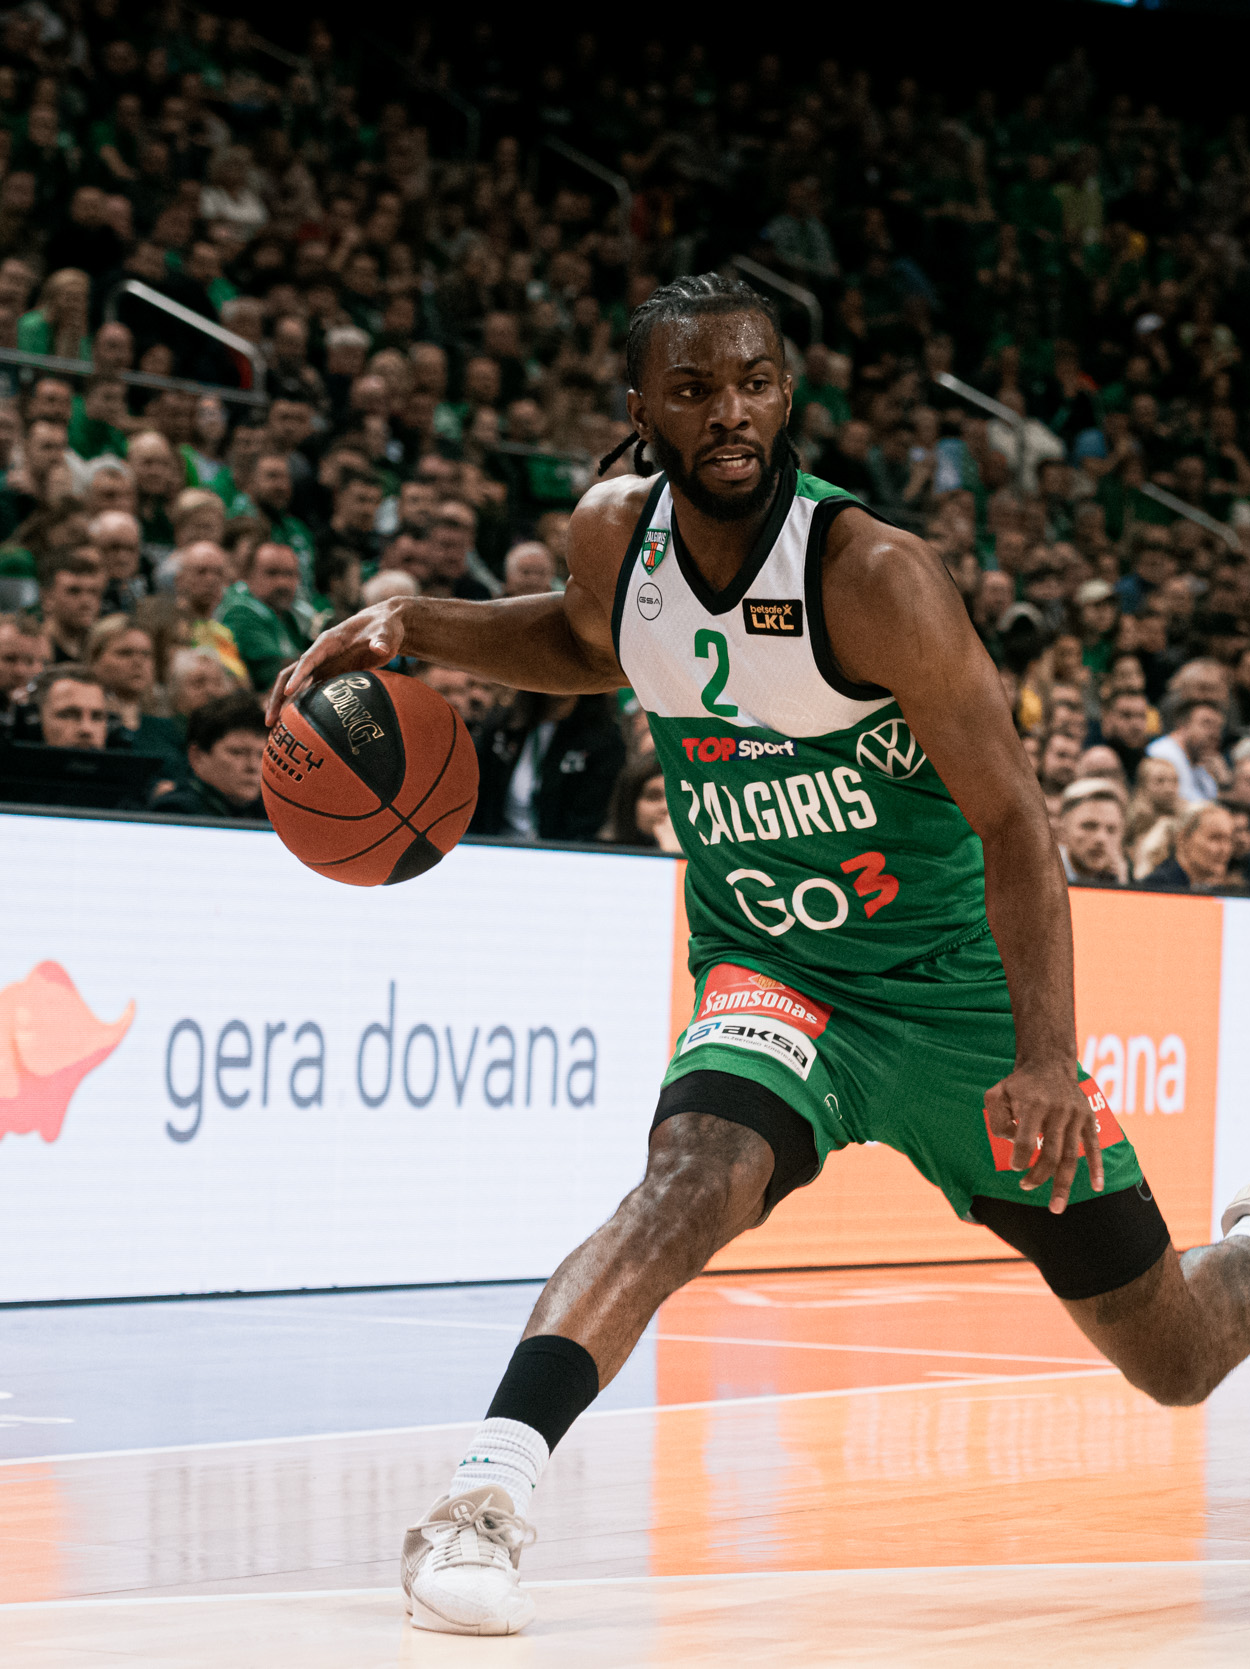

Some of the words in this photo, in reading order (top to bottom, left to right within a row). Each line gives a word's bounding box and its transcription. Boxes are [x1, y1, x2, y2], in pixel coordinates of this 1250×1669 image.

[750, 605, 783, 614] betsafe
[751, 613, 795, 630] LKL
[694, 628, 739, 717] 2
[700, 990, 818, 1025] Samsonas
[165, 1018, 326, 1143] gera
[356, 979, 599, 1109] dovana
